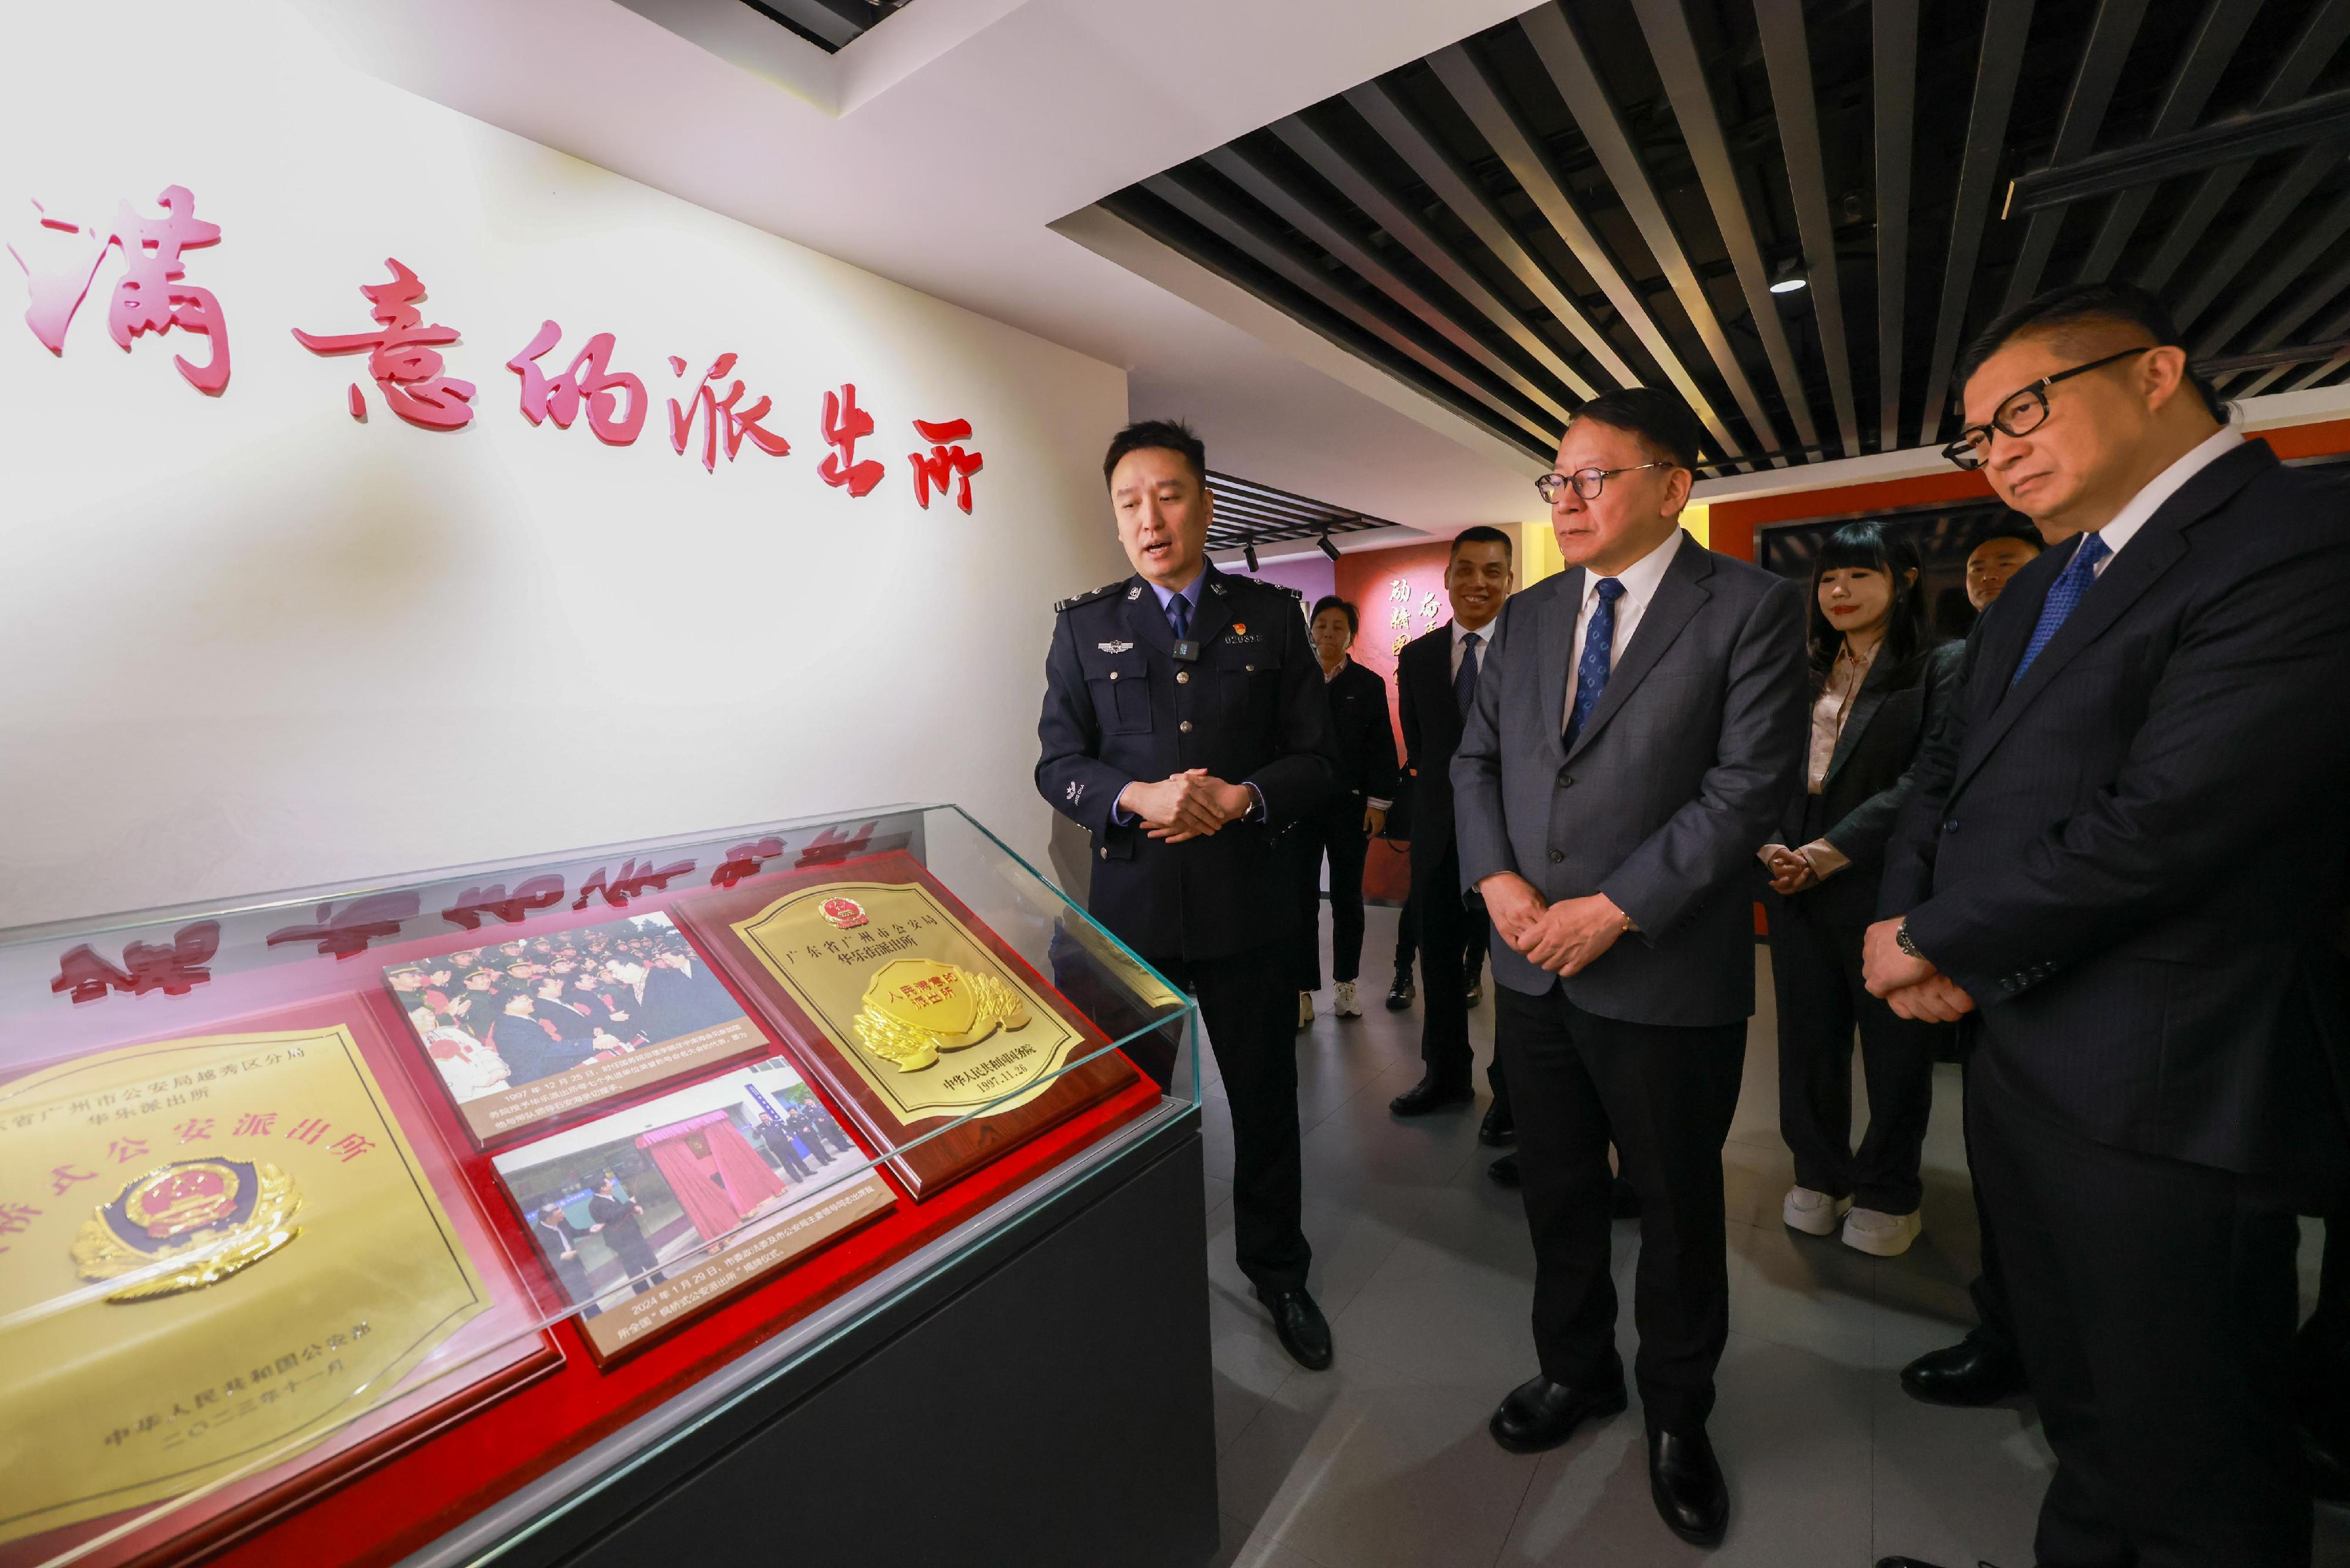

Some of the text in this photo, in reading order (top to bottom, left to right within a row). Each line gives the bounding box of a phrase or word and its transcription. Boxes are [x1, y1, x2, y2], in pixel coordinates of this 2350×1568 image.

[786, 914, 938, 965] 广东省广州市公安局
[838, 935, 918, 965] 华乐街派出所
[888, 972, 958, 1003] 人民满意的
[911, 986, 956, 1010] 派出所
[942, 1043, 1037, 1090] 中华人民共和国国务院
[976, 1064, 1028, 1093] 1997.11.26
[88, 1086, 210, 1126] 华乐派出所
[504, 1090, 527, 1102] 1997
[631, 1297, 658, 1315] 2024
[105, 1321, 371, 1446] 中华人民共和国公安部
